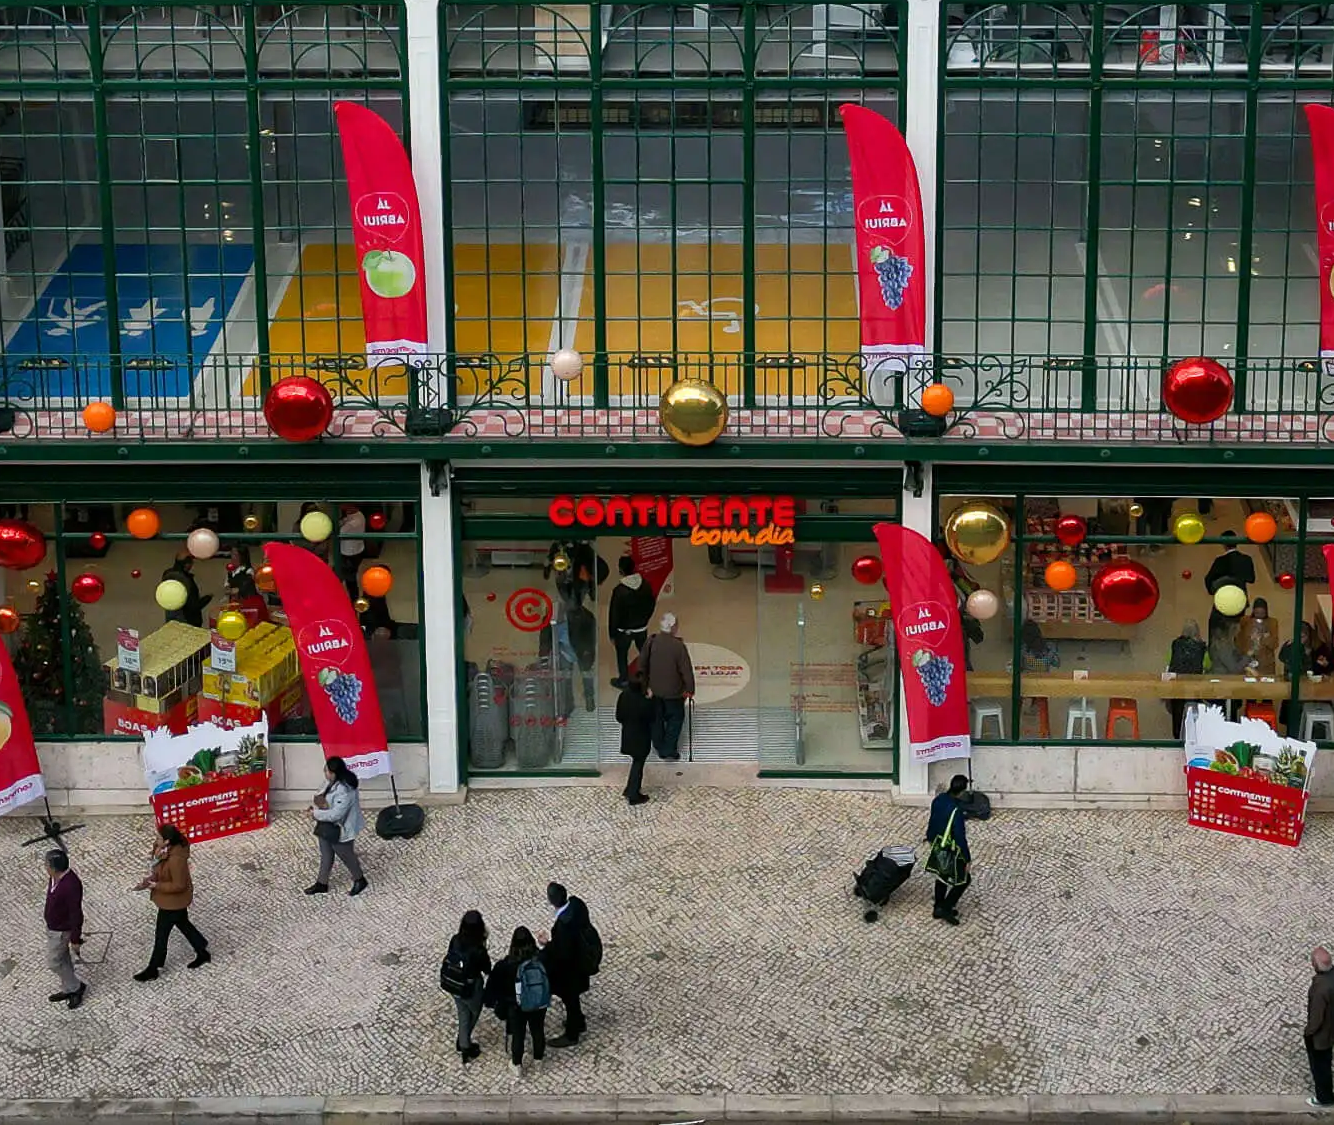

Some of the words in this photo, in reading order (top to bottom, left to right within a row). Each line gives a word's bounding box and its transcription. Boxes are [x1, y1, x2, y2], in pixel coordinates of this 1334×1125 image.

[548, 493, 796, 528] CONTINENTE
[185, 790, 238, 809] CONTINENTE
[1217, 786, 1271, 803] CONTINENTE
